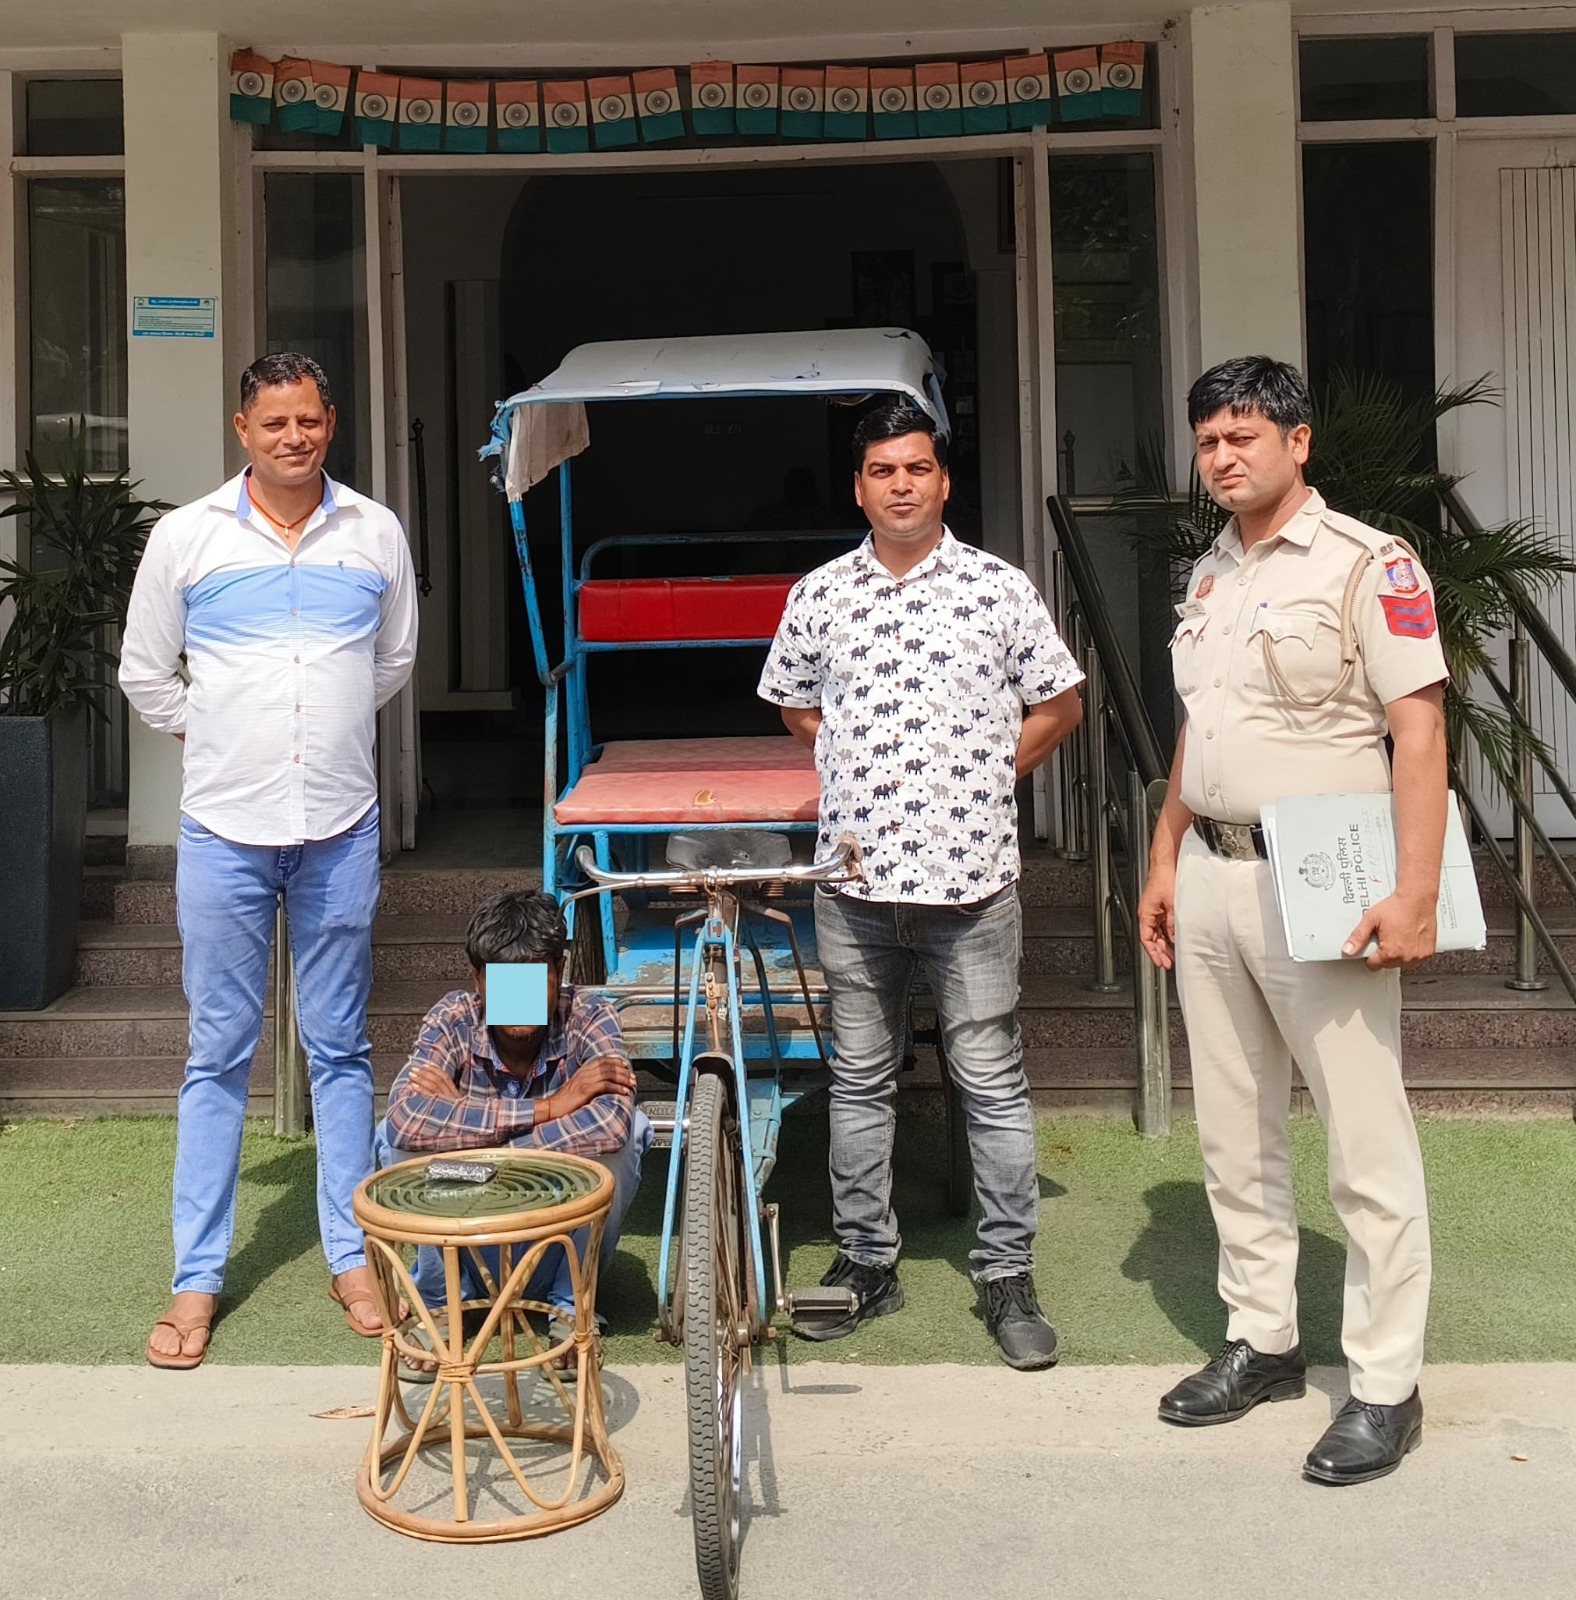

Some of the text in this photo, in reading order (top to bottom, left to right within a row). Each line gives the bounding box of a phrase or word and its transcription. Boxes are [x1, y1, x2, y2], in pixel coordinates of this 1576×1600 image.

[1336, 837, 1355, 904] दिल्ली पुलिस
[1349, 823, 1365, 873] POLICE
